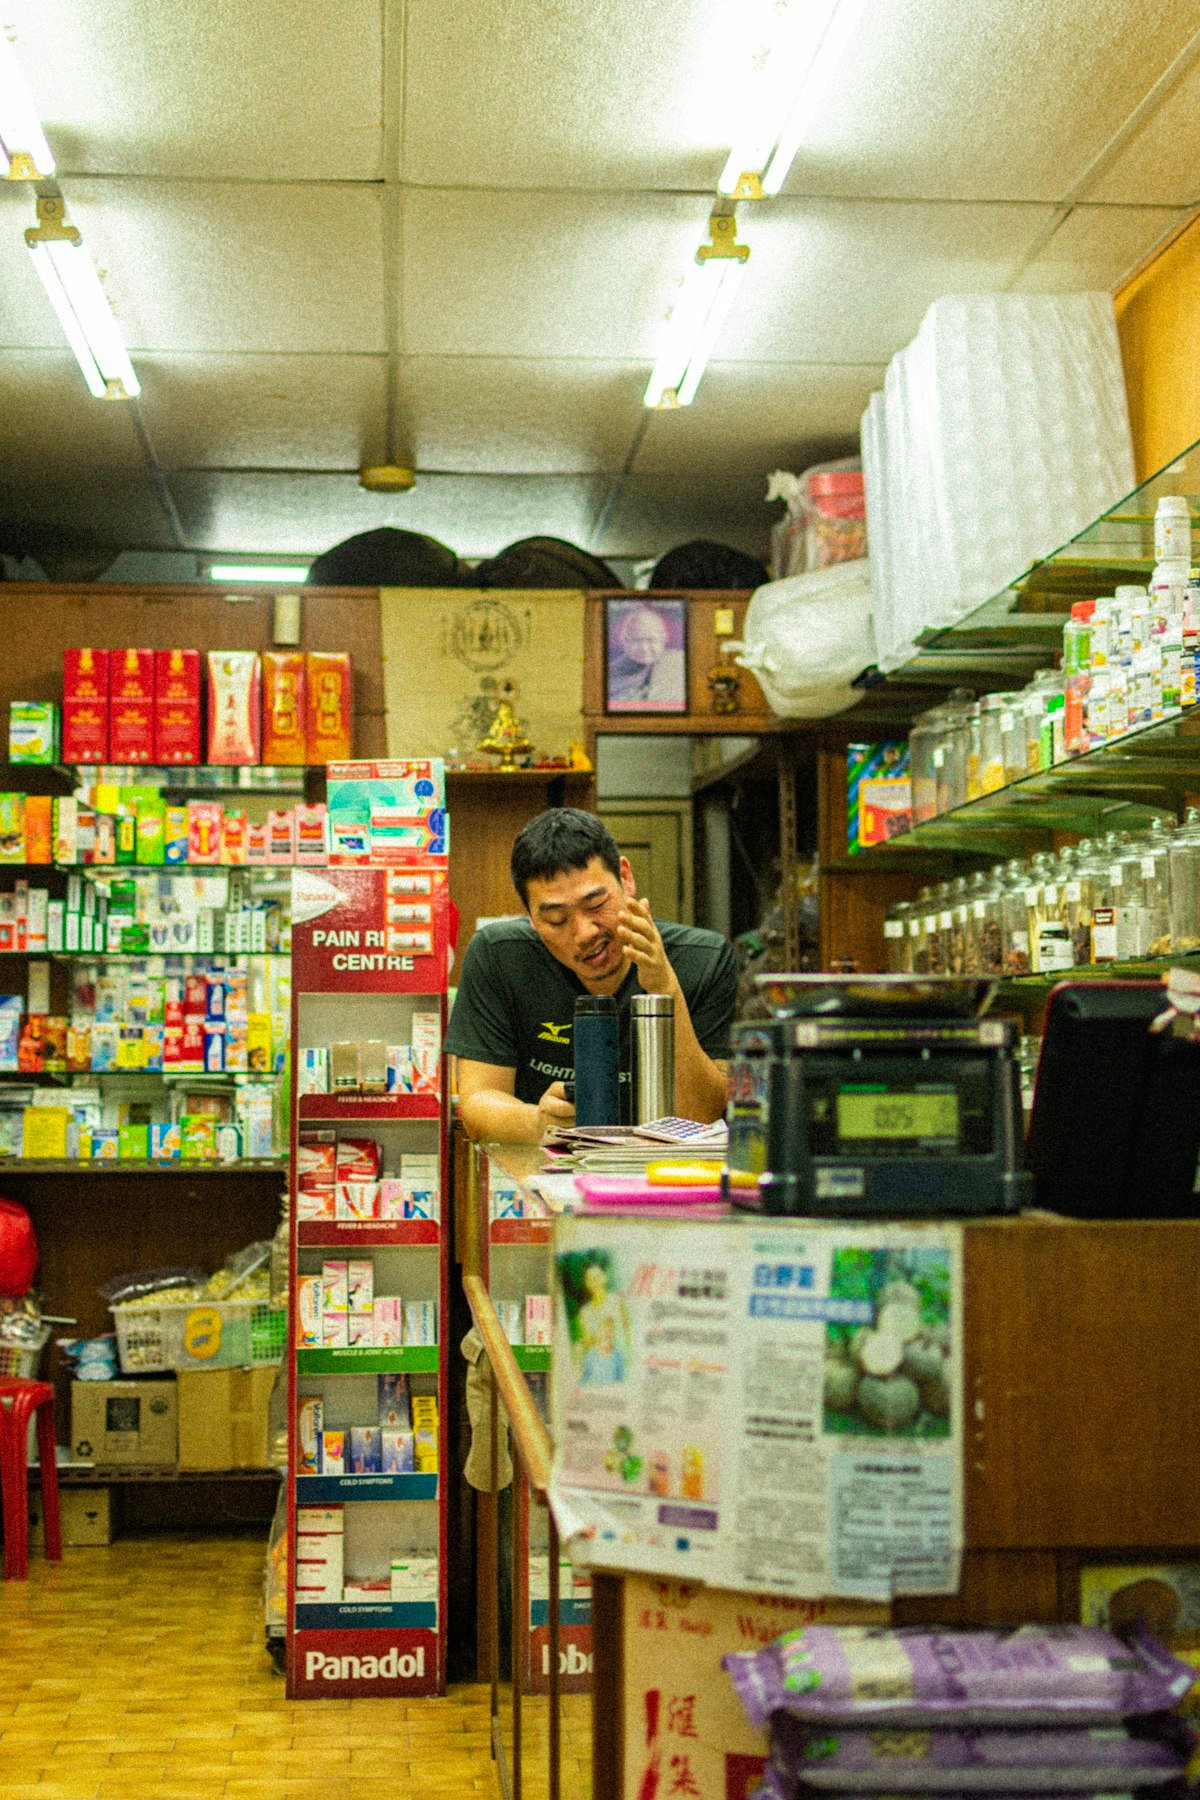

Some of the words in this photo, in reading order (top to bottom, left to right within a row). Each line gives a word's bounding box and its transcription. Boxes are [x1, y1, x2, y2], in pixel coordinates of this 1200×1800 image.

[312, 929, 360, 948] PAIN
[332, 953, 415, 972] CENTRE
[339, 1478, 358, 1486] COLD
[339, 1606, 358, 1614] COLD
[305, 1646, 425, 1681] Panadol
